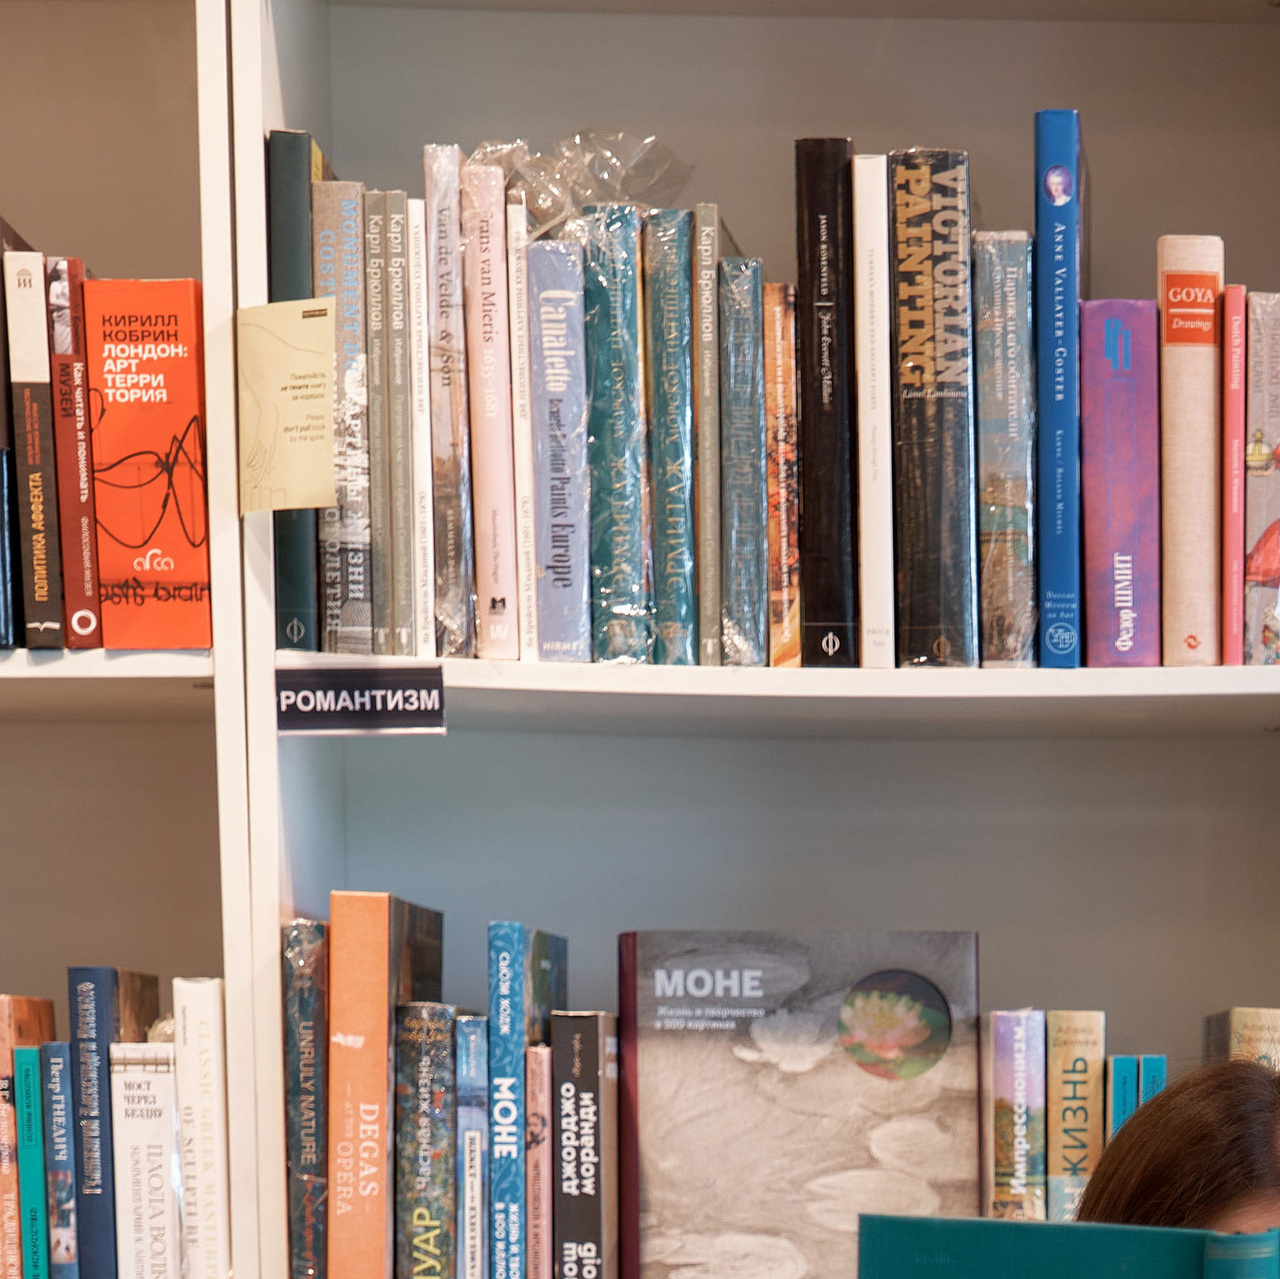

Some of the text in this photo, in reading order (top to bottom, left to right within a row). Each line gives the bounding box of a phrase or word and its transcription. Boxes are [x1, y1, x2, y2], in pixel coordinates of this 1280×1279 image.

[387, 214, 404, 254] Карл
[342, 200, 359, 334] MONUMENT
[367, 215, 384, 330] Карл Брюллов
[388, 258, 405, 330] Брюллов
[697, 226, 715, 342] Карл Брюллов
[818, 244, 828, 295] ROSENFELD
[896, 165, 934, 387] PAINTING
[932, 165, 968, 386] VICTORIAN
[1168, 287, 1215, 302] GOYA
[102, 315, 178, 327] КИРИЛЛ
[103, 330, 178, 341] КОБРИН
[438, 272, 453, 341] Velde &
[481, 291, 495, 344] Mieris
[1054, 222, 1068, 401] ANNE VALLAYER-COSTER
[1172, 318, 1212, 331] Drawings
[74, 362, 84, 384] Как
[103, 344, 188, 359] ЛОНДОН:
[103, 360, 137, 373] АРТ
[104, 374, 164, 388] ТЕРРИ
[59, 363, 74, 418] МУЗЕЙ
[74, 386, 86, 429] читать
[105, 389, 167, 402] ТОРИЯ
[539, 290, 577, 588] Canaletto Paints Europe
[29, 472, 44, 530] АФФЕКТА
[77, 441, 89, 502] понимать
[33, 532, 48, 601] ПОЛИТИКА
[1114, 552, 1133, 608] ШМИТ
[280, 690, 440, 711] РОМАНТИЗМ
[654, 969, 764, 998] МОНЕ
[48, 1057, 64, 1093] Петр
[299, 1020, 316, 1090] UNRULY
[416, 1057, 432, 1115] жизнь
[299, 1095, 316, 1164] NATURE
[493, 1077, 518, 1159] МОНЕ
[561, 1082, 578, 1195] джорджо
[578, 1092, 598, 1195] моранди
[1062, 1057, 1088, 1177] ЖИЗНЬ
[336, 1141, 358, 1216] OPÉRA
[358, 1103, 380, 1196] DEGAS
[147, 1144, 165, 1220] ПАОЛА
